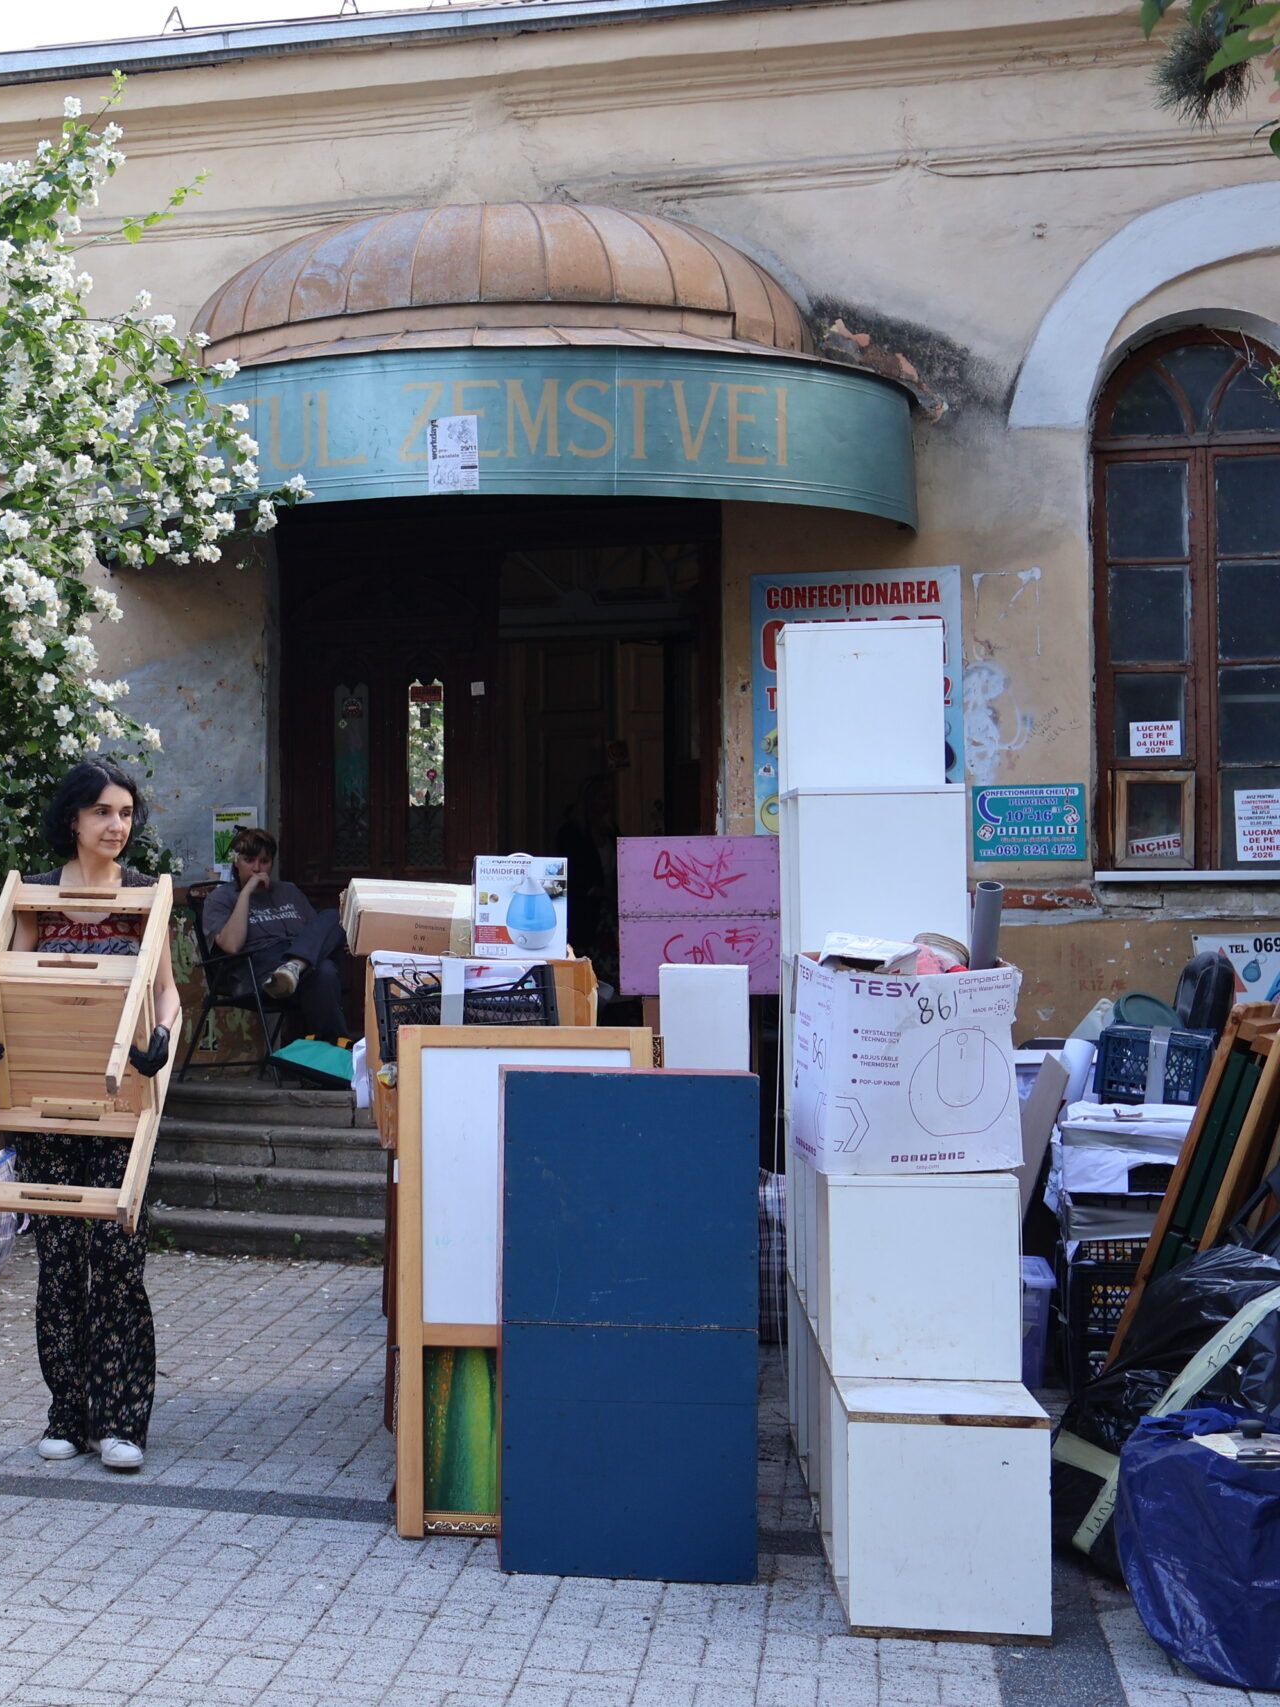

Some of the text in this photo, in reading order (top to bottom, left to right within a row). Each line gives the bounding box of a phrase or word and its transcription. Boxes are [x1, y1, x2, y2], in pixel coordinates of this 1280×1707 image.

[399, 378, 788, 467] ZEMSTVEI
[767, 580, 941, 613] CONFECȚIONAREA
[1149, 739, 1174, 747] IUNIE
[996, 845, 1019, 856] 069
[1024, 845, 1048, 855] 324
[1052, 844, 1076, 855] 472
[480, 868, 525, 876] HUMIDIFIER
[1228, 944, 1250, 954] TEL.
[958, 974, 1000, 985] Compact
[849, 977, 920, 998] TESY
[917, 989, 958, 1025] 861
[861, 1035, 900, 1044] TECHNOLOGY
[860, 1054, 899, 1062] ADJUSTABLE
